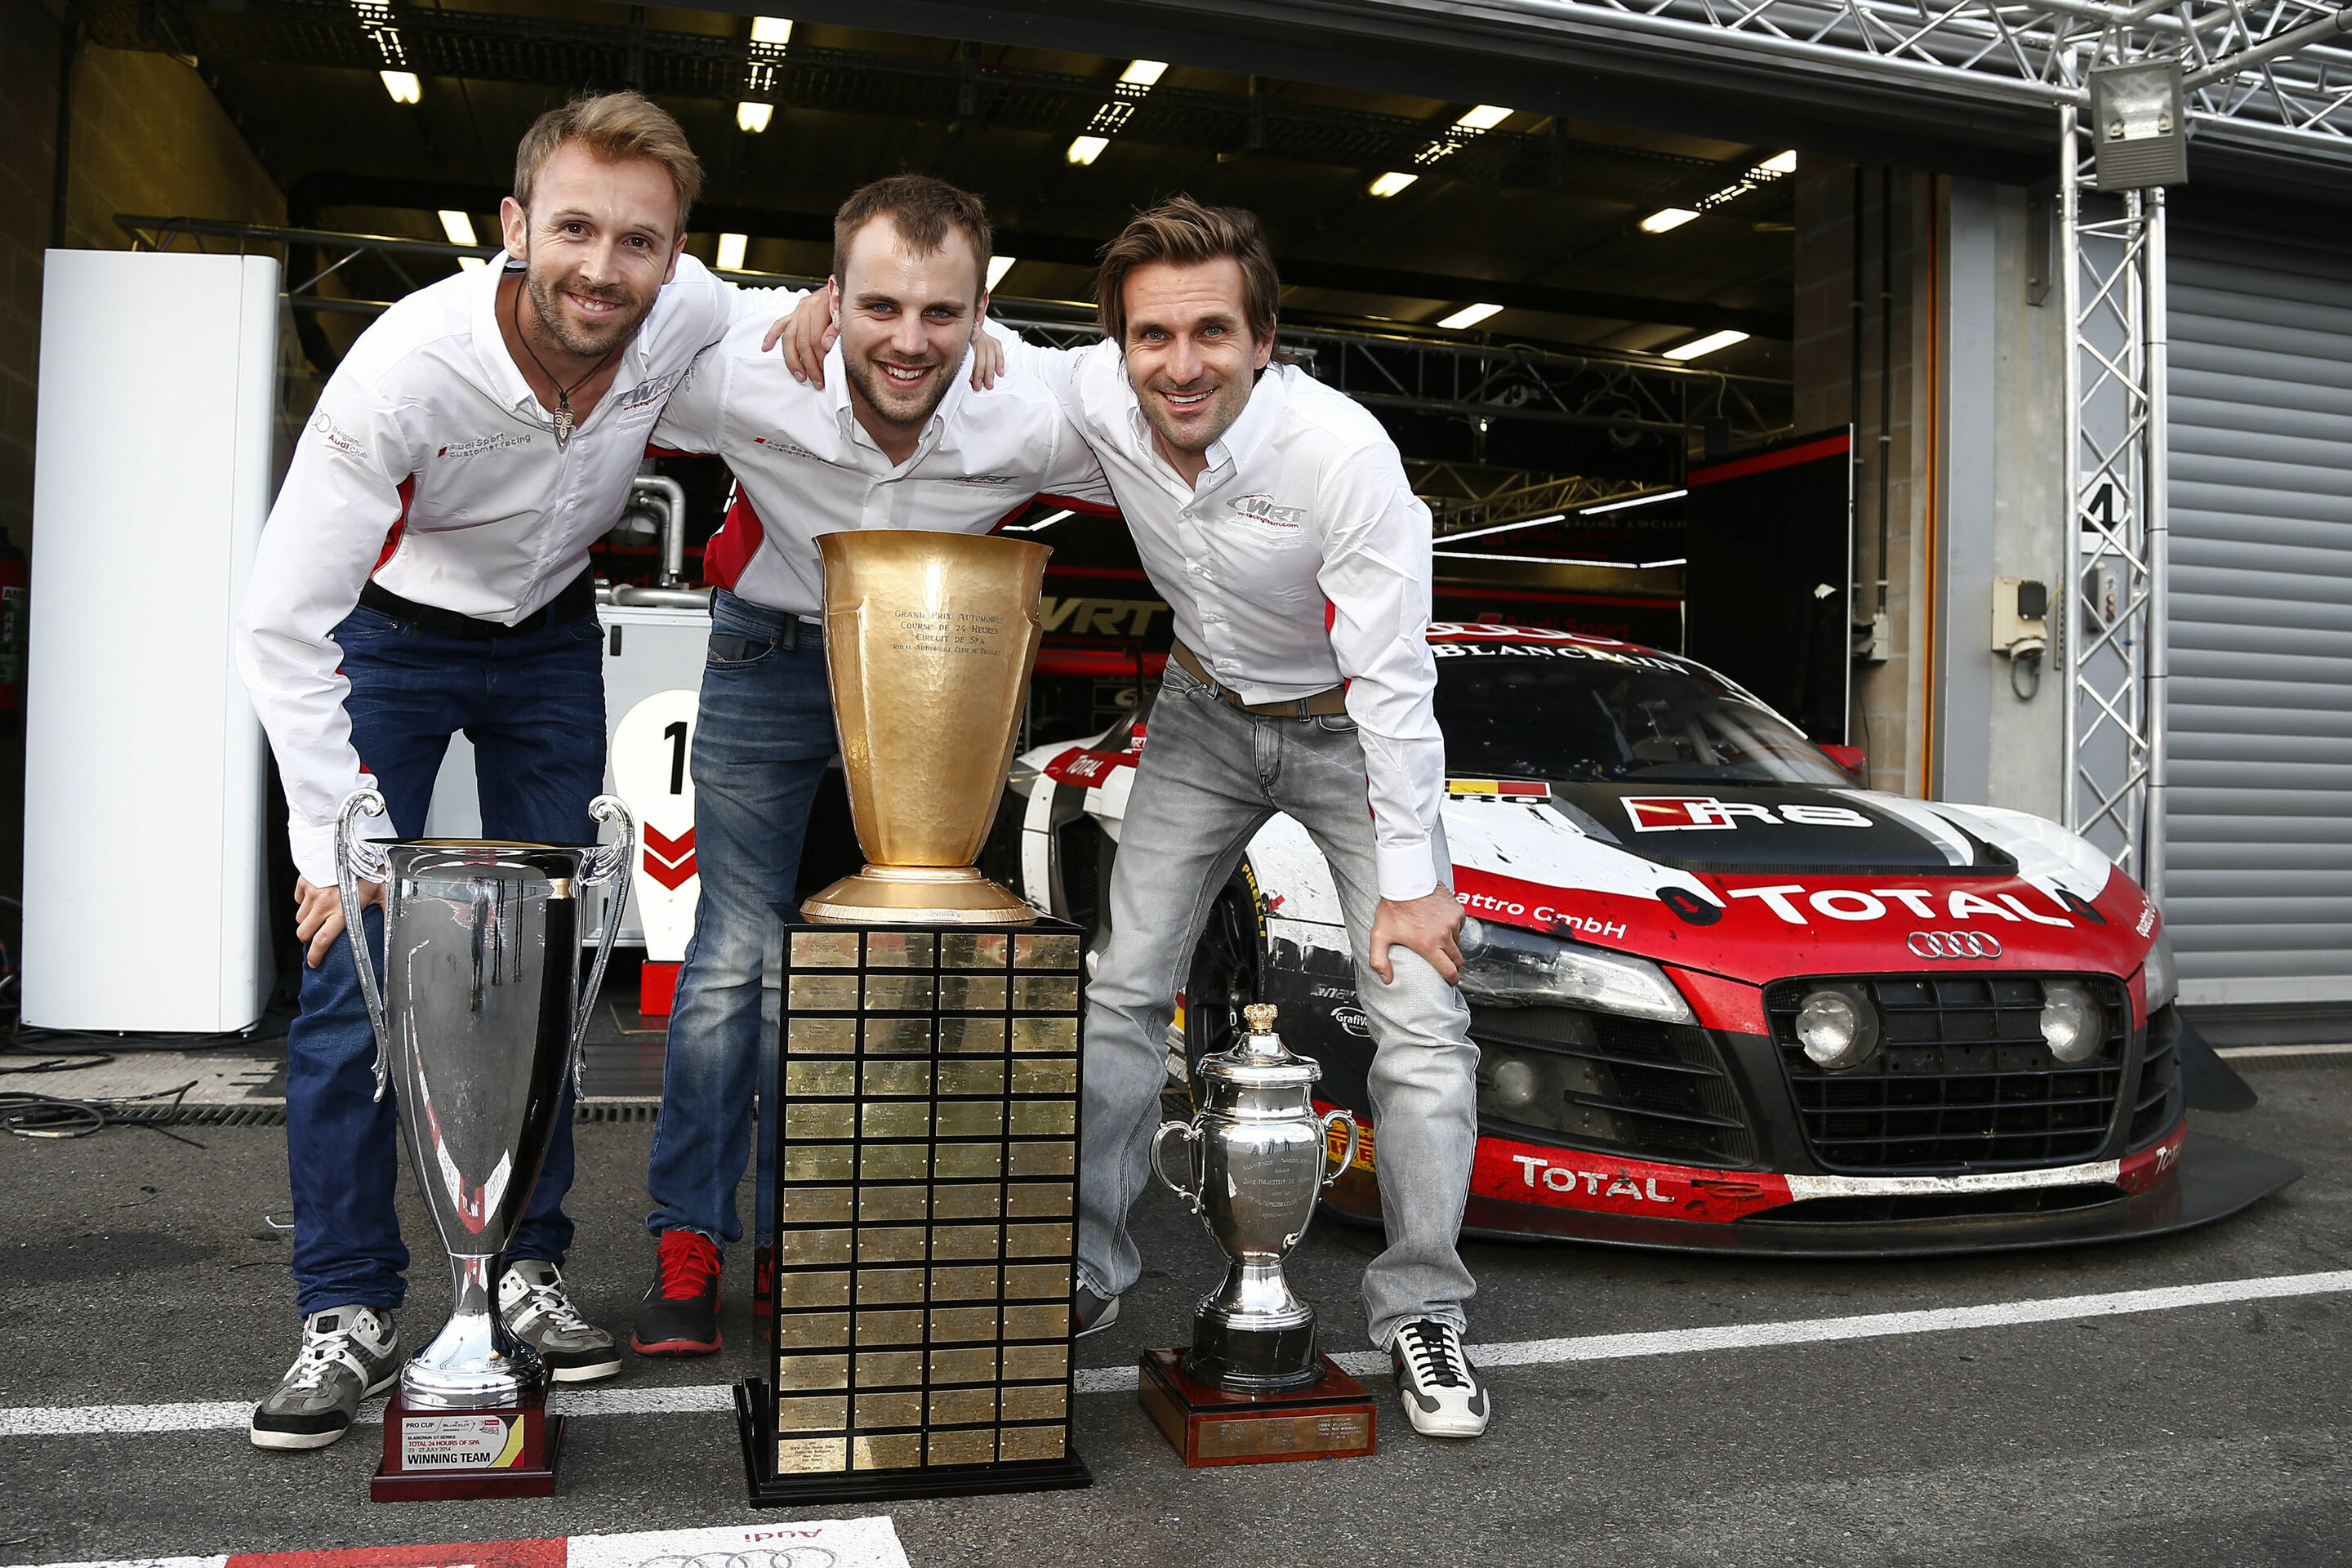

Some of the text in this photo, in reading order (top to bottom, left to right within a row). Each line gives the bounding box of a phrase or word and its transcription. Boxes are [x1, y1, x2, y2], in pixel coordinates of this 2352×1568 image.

[328, 434, 368, 458] Audi Club
[332, 425, 359, 446] Belgian
[450, 434, 531, 457] customer racing
[451, 433, 505, 451] Audi Sport
[1247, 498, 1307, 523] WRT
[2082, 483, 2120, 545] 4
[894, 609, 1004, 624] GRAND PRIX AUTOMOBILE
[901, 621, 932, 630] COURSE
[956, 624, 965, 632] 24
[972, 625, 999, 635] HEURES
[893, 643, 912, 651] ROYAL
[915, 633, 948, 643] CIRCUIT
[969, 636, 985, 645] SPA
[1435, 643, 1690, 675] BLANCPAIN
[663, 721, 688, 795] 1
[1066, 755, 1104, 777] TOTAL
[1682, 801, 1874, 828] R8
[1241, 863, 1267, 938] PIRELLI
[1727, 884, 2075, 929] TOTAL
[1533, 906, 1628, 940] GmbH
[1512, 1154, 1675, 1203] TOTAL
[408, 1453, 490, 1464] WINNING TEAM
[744, 1528, 823, 1543] Audi
